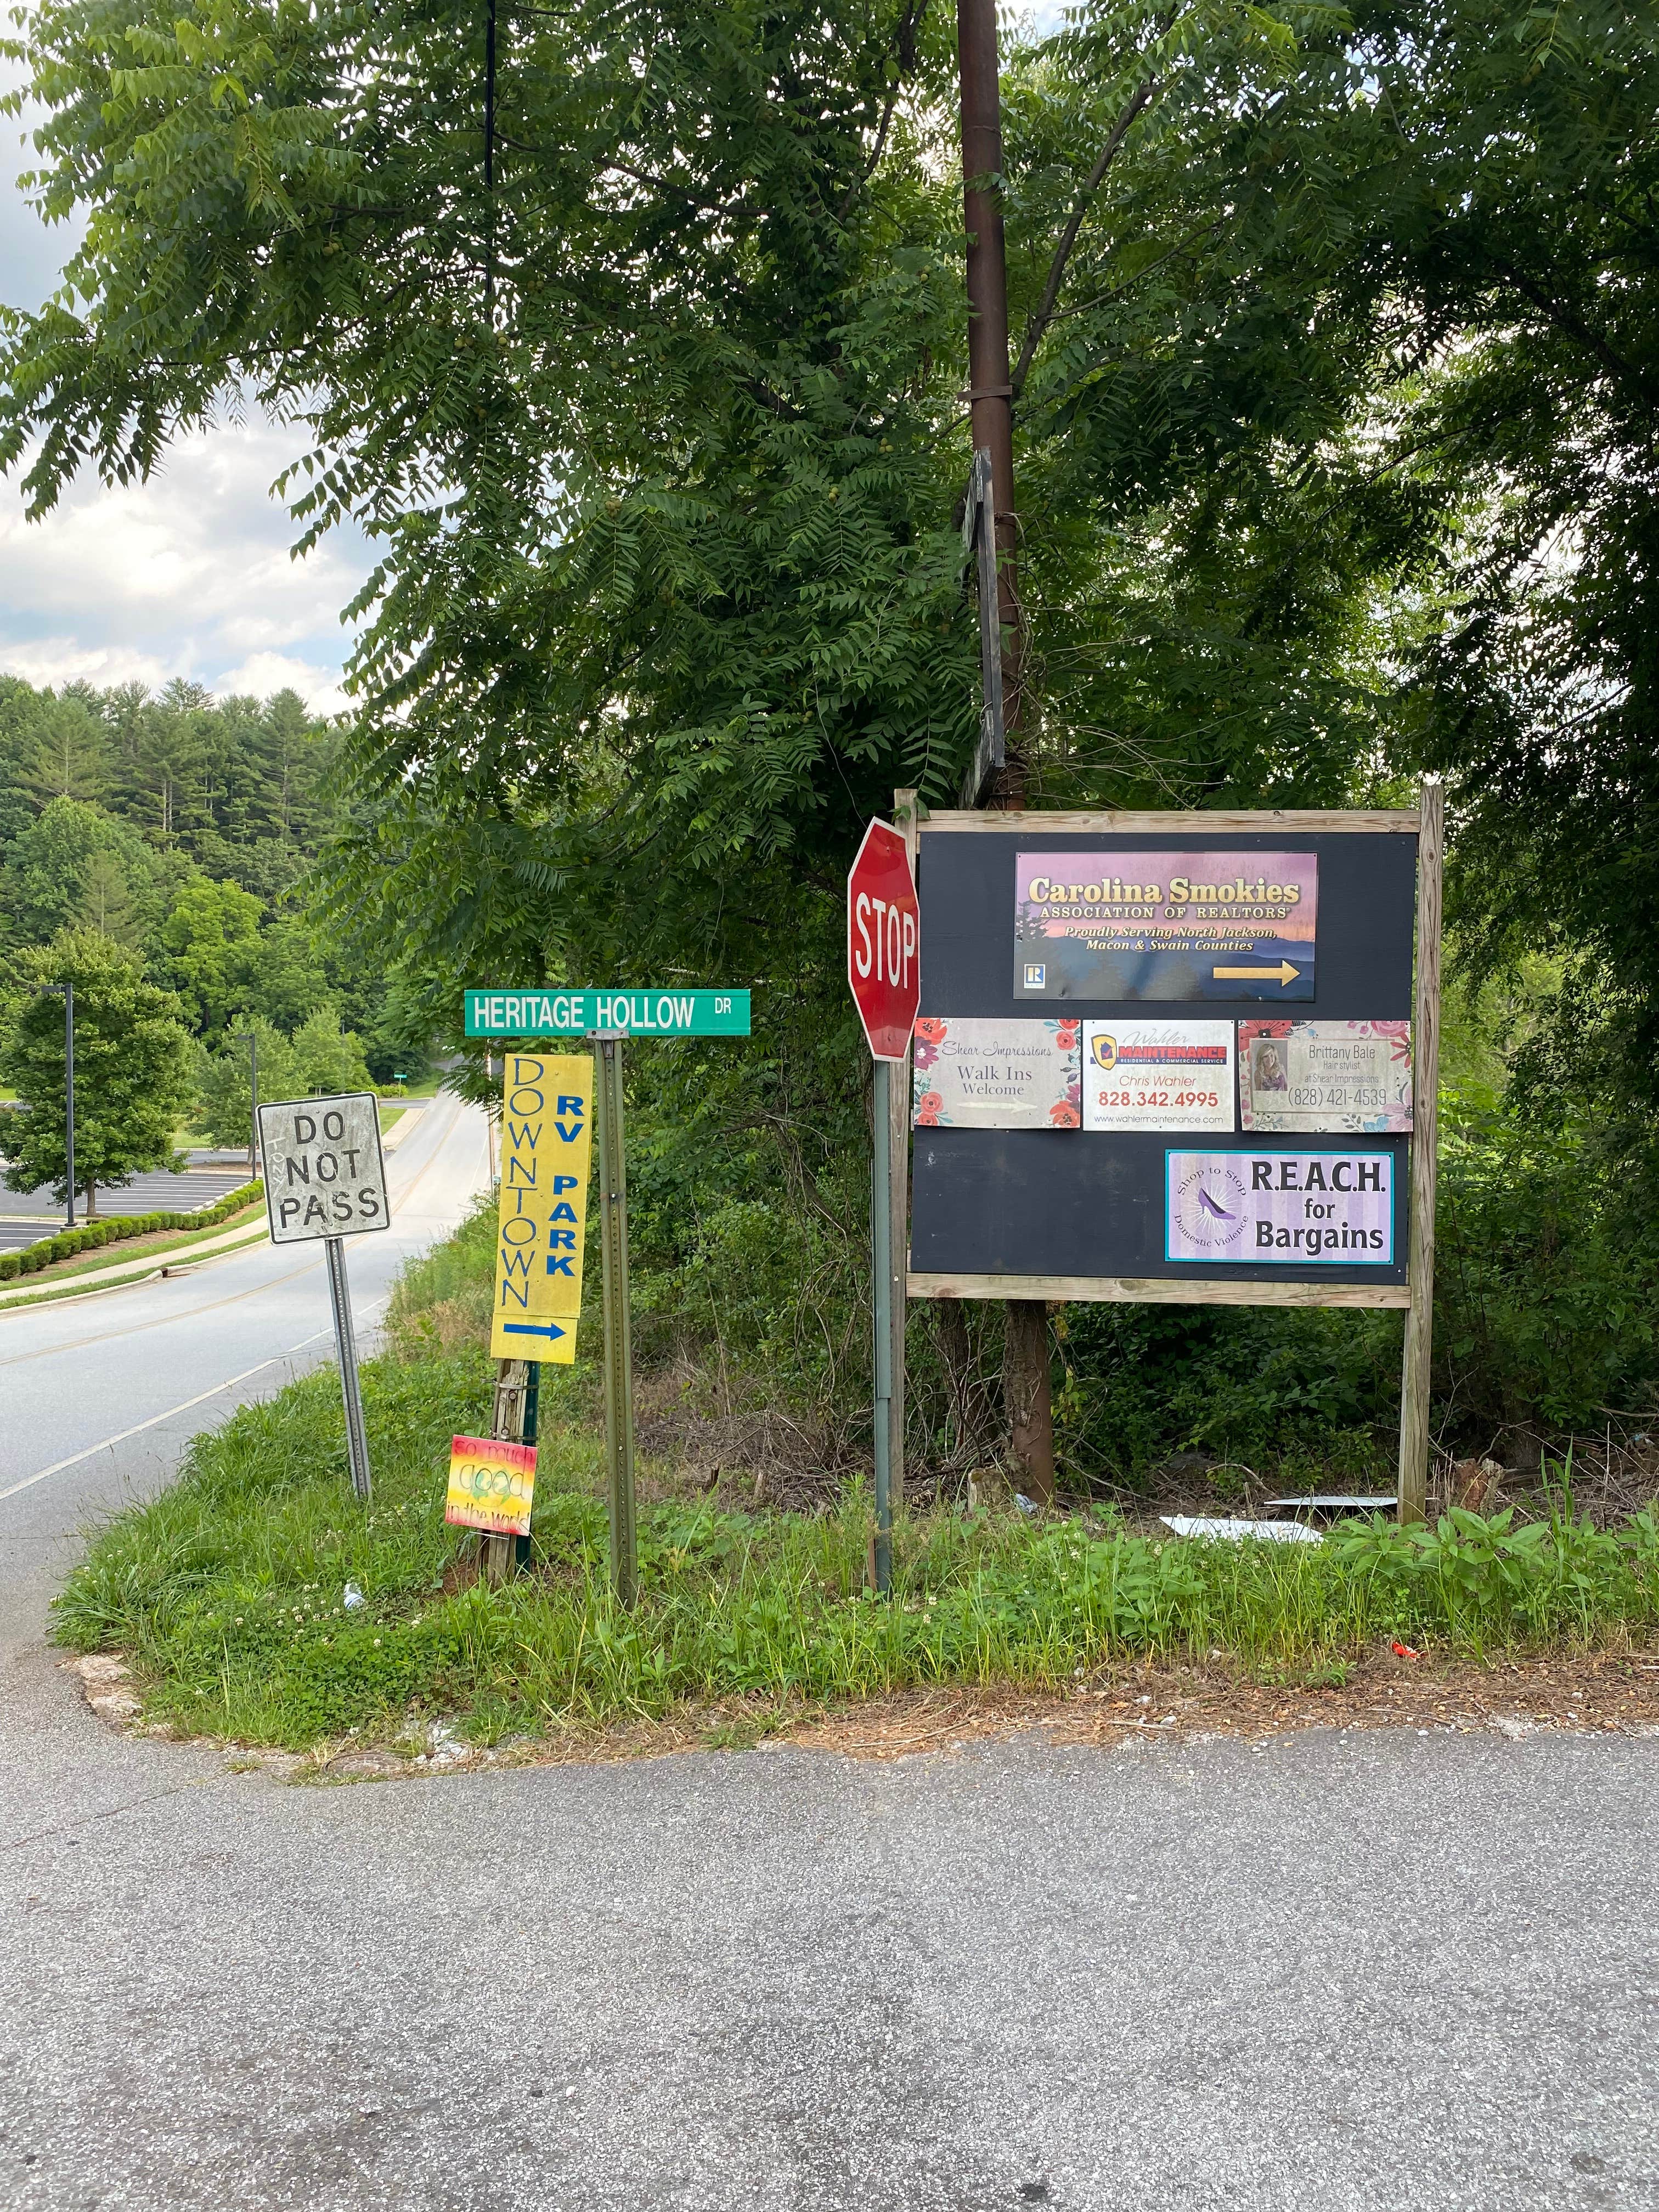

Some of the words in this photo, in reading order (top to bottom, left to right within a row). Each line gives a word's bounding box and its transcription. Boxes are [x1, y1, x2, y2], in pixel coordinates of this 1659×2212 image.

[1029, 877, 1163, 903] Carolina
[1169, 877, 1299, 903] Smokies
[1040, 907, 1154, 918] ASSOCIATION
[1164, 907, 1186, 918] OF
[855, 891, 916, 990] STOP
[1064, 927, 1118, 939] Proudly
[1121, 927, 1173, 939] Serving
[1177, 927, 1217, 938] North
[1220, 927, 1277, 939] Jackson,
[1086, 940, 1129, 950] Macon
[1135, 940, 1145, 950] &
[1149, 940, 1189, 950] Swain
[1195, 940, 1254, 951] Counties
[474, 996, 584, 1028] HERITAGE
[597, 996, 695, 1028] HOLLOW
[715, 997, 731, 1014] DR
[1122, 1028, 1190, 1046] Wahler
[942, 1041, 979, 1056] Shear
[983, 1041, 1053, 1059] Impressions
[1119, 1046, 1227, 1058] MAINTENANCE
[1309, 1045, 1351, 1060] Brittany
[1353, 1045, 1375, 1059] Bale
[957, 1065, 999, 1081] Walk
[1006, 1066, 1032, 1081] Ins
[1323, 1060, 1339, 1069] Hair
[1339, 1061, 1361, 1071] stylist
[963, 1083, 1024, 1096] Welcome
[1119, 1075, 1149, 1086] Chris
[1154, 1075, 1197, 1086] Wahler
[1305, 1075, 1312, 1083] at
[1313, 1074, 1334, 1083] Shear
[1335, 1074, 1379, 1085] Impressions
[1099, 1091, 1218, 1107] 828.342.4995
[1289, 1087, 1323, 1107] (828)
[1327, 1088, 1387, 1105] 421-4539
[294, 1111, 345, 1144] DO
[554, 1095, 584, 1143] RV
[1093, 1115, 1223, 1124] www.wahlermaintenance.com
[286, 1149, 360, 1186] NOT
[1251, 1161, 1386, 1192] R.E.A.C.H.
[501, 1058, 544, 1308] DOWNTOWN
[1177, 1169, 1205, 1195] Shop
[1224, 1170, 1247, 1196] Stop
[280, 1188, 379, 1228] PASS
[1304, 1198, 1335, 1219] for
[546, 1175, 579, 1277] PARK
[1174, 1215, 1212, 1247] Domestic
[1214, 1216, 1249, 1246] Violence
[1256, 1221, 1384, 1256] Bargains
[488, 1446, 533, 1465] much
[459, 1462, 525, 1500] good
[447, 1501, 460, 1521] in
[465, 1503, 489, 1525] the
